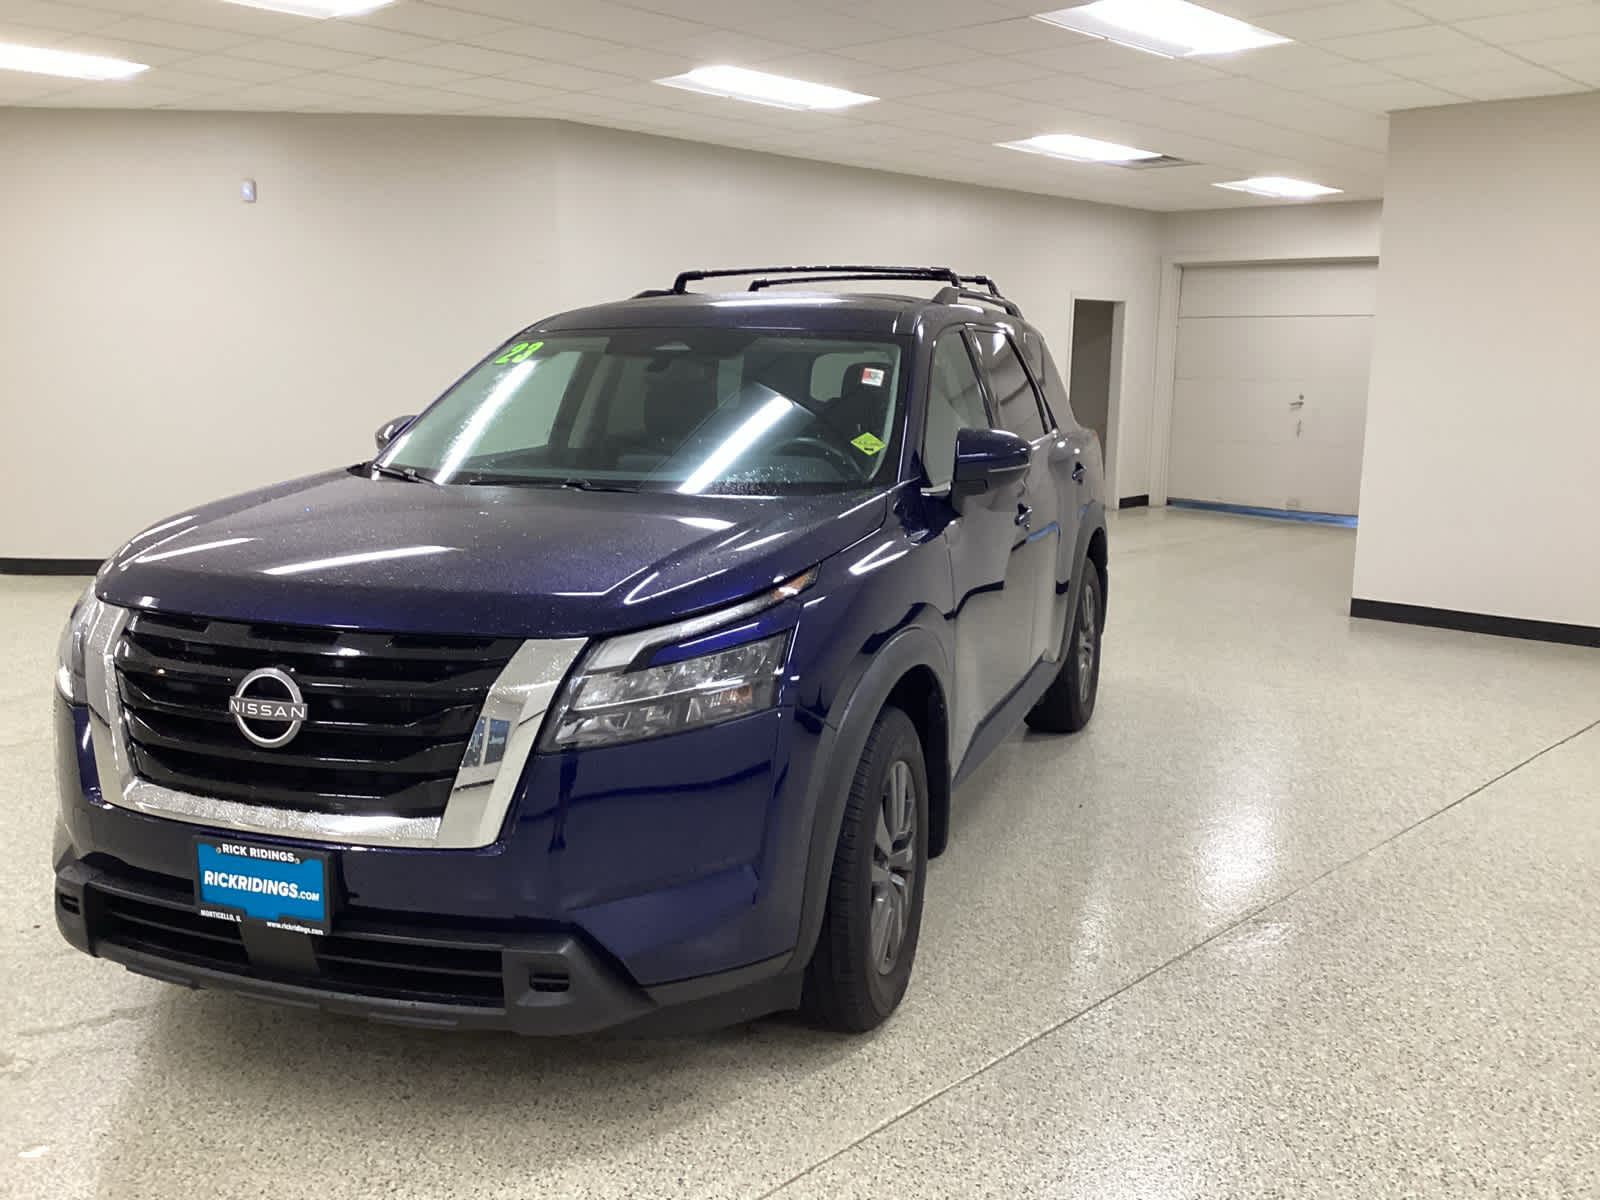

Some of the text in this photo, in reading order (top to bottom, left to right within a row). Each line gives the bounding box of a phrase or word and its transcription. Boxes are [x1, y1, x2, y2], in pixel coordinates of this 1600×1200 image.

[495, 341, 544, 363] 23
[230, 699, 305, 719] NISSAN
[222, 843, 295, 862] RICK RIDINGS
[204, 870, 320, 902] RICKRIDINGS.COM
[266, 921, 324, 935] www.rickridings.com
